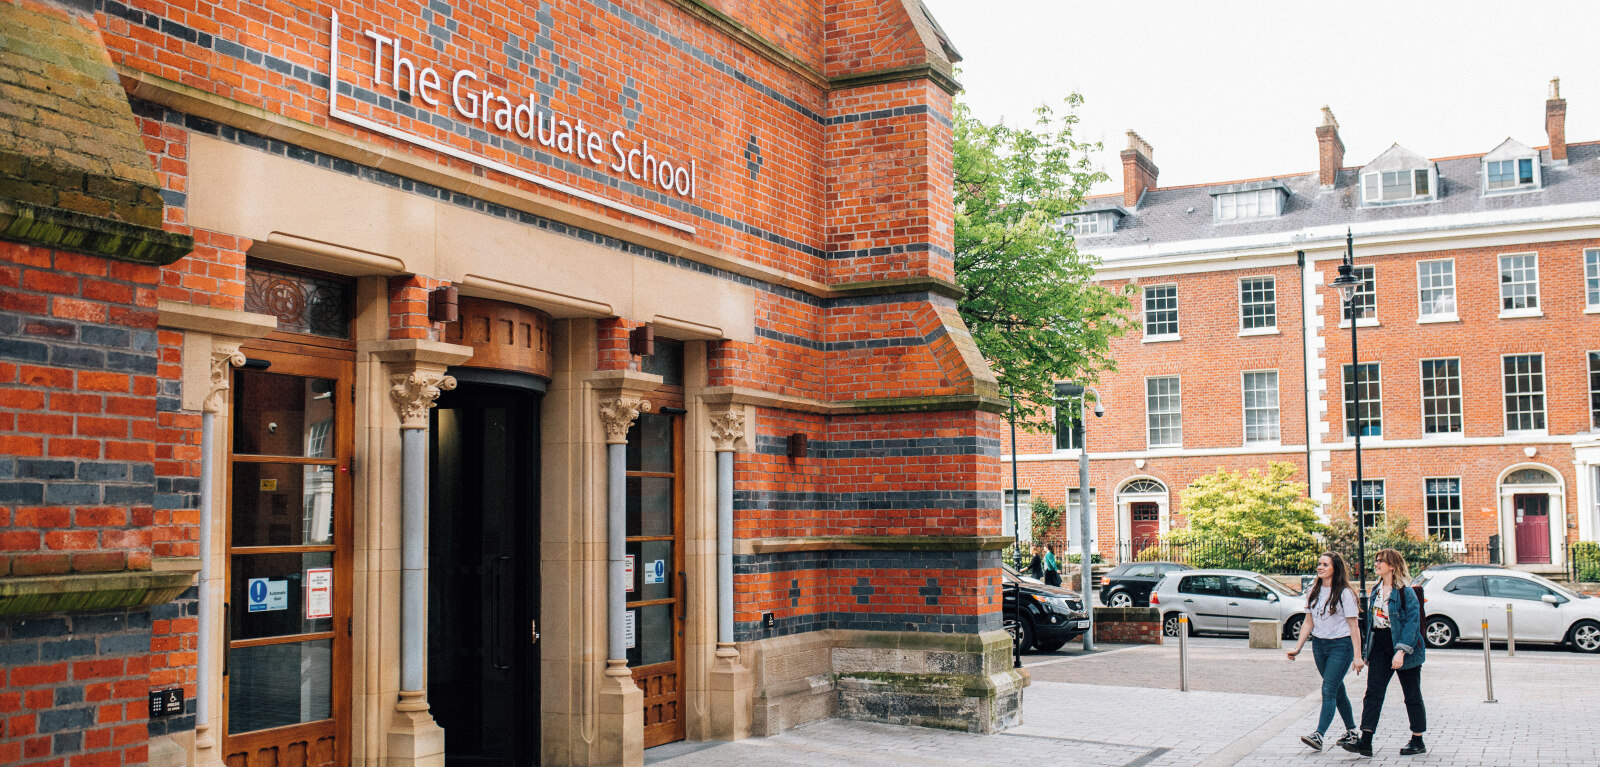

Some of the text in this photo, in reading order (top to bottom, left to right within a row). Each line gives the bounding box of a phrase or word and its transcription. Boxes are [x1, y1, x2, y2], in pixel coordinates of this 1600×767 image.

[365, 29, 696, 199] The Graduate School
